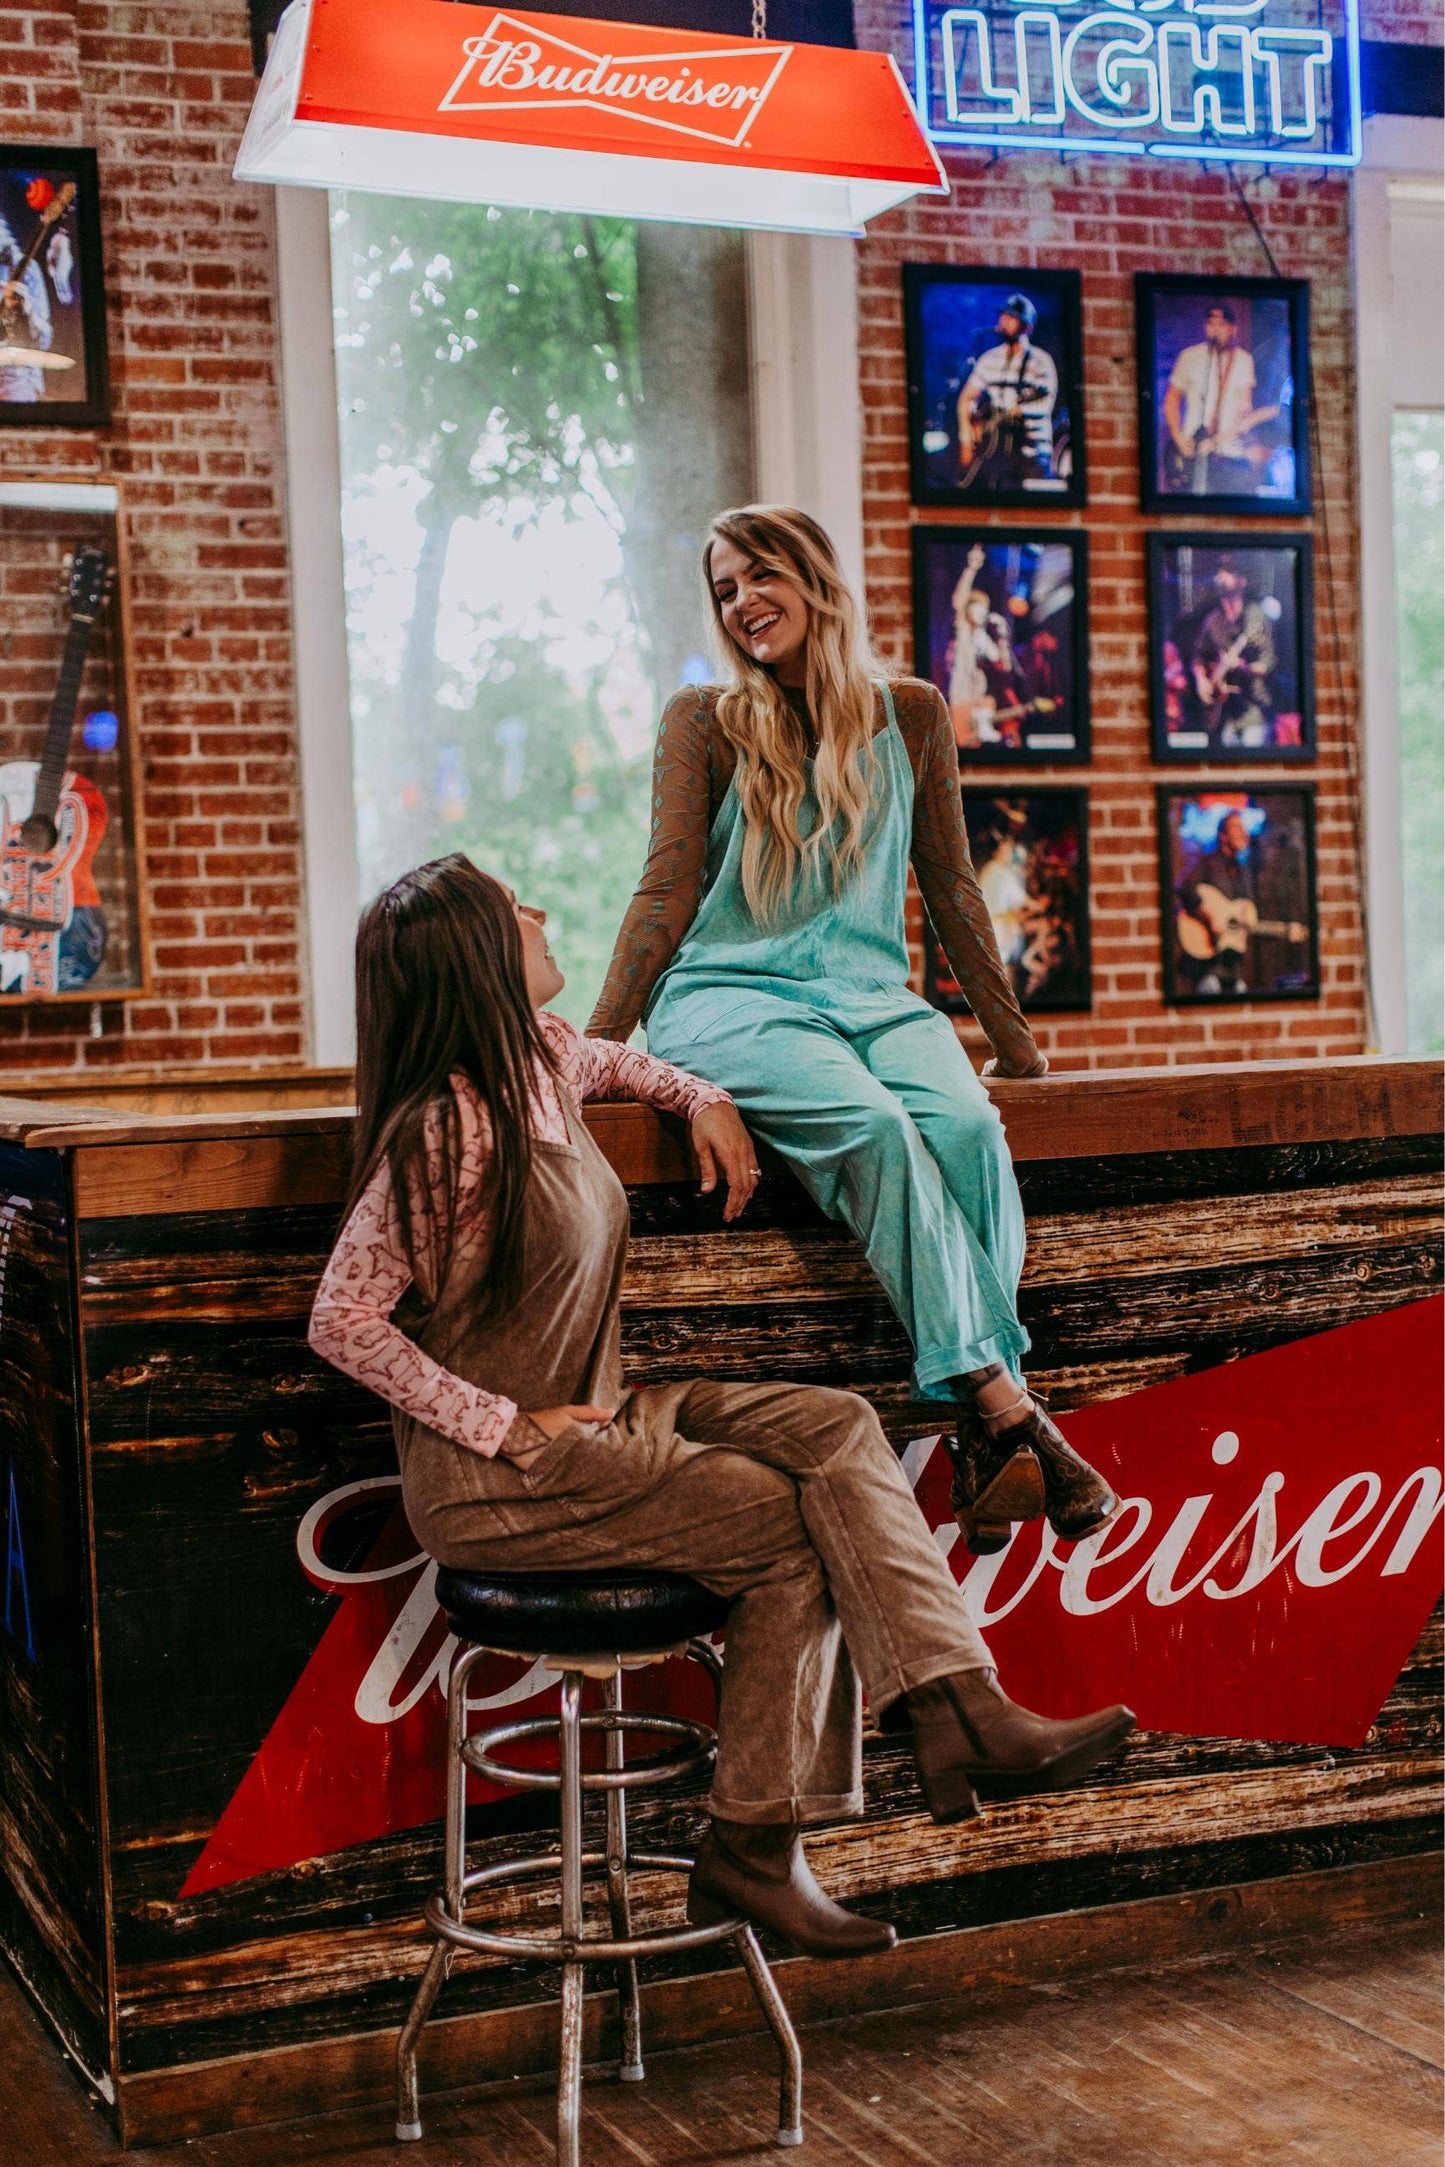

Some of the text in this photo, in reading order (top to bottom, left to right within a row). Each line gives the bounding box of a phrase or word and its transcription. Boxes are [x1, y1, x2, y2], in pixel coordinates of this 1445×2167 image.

[462, 35, 763, 112] Budweiser
[941, 10, 1333, 138] LIGHT
[296, 1431, 1444, 1724] weiser
